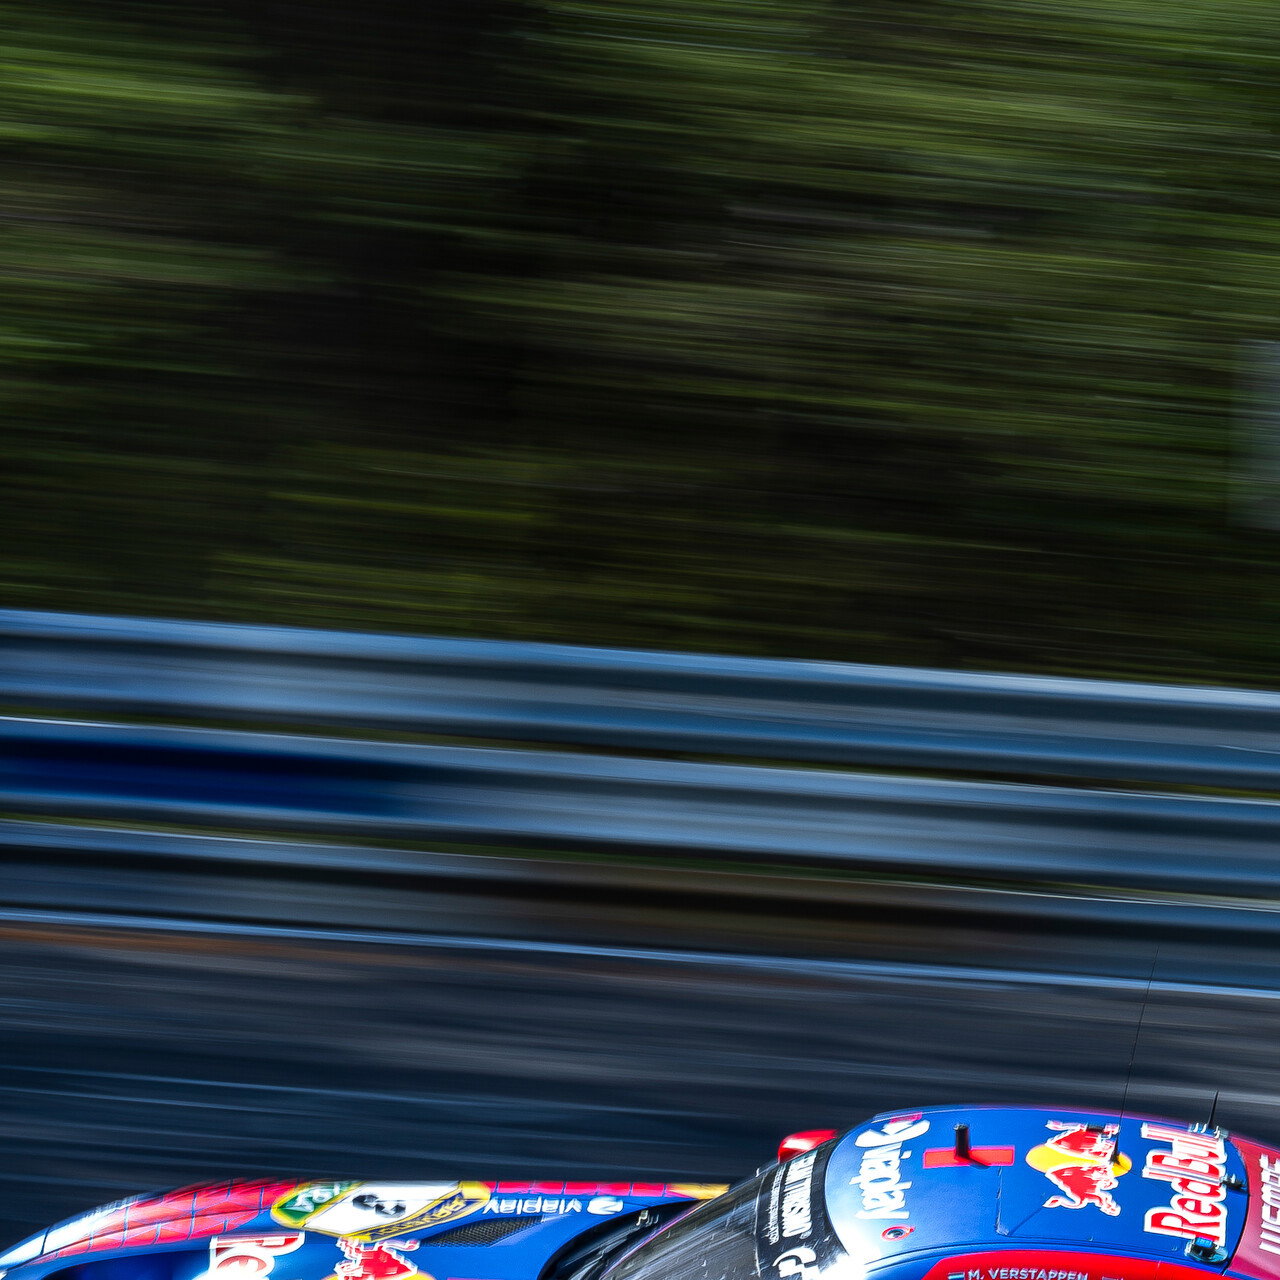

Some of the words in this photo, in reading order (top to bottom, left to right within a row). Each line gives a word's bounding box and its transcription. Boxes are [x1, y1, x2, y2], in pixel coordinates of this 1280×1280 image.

[351, 1193, 407, 1219] 3
[482, 1196, 583, 1215] viaplay
[967, 1269, 985, 1280] M.
